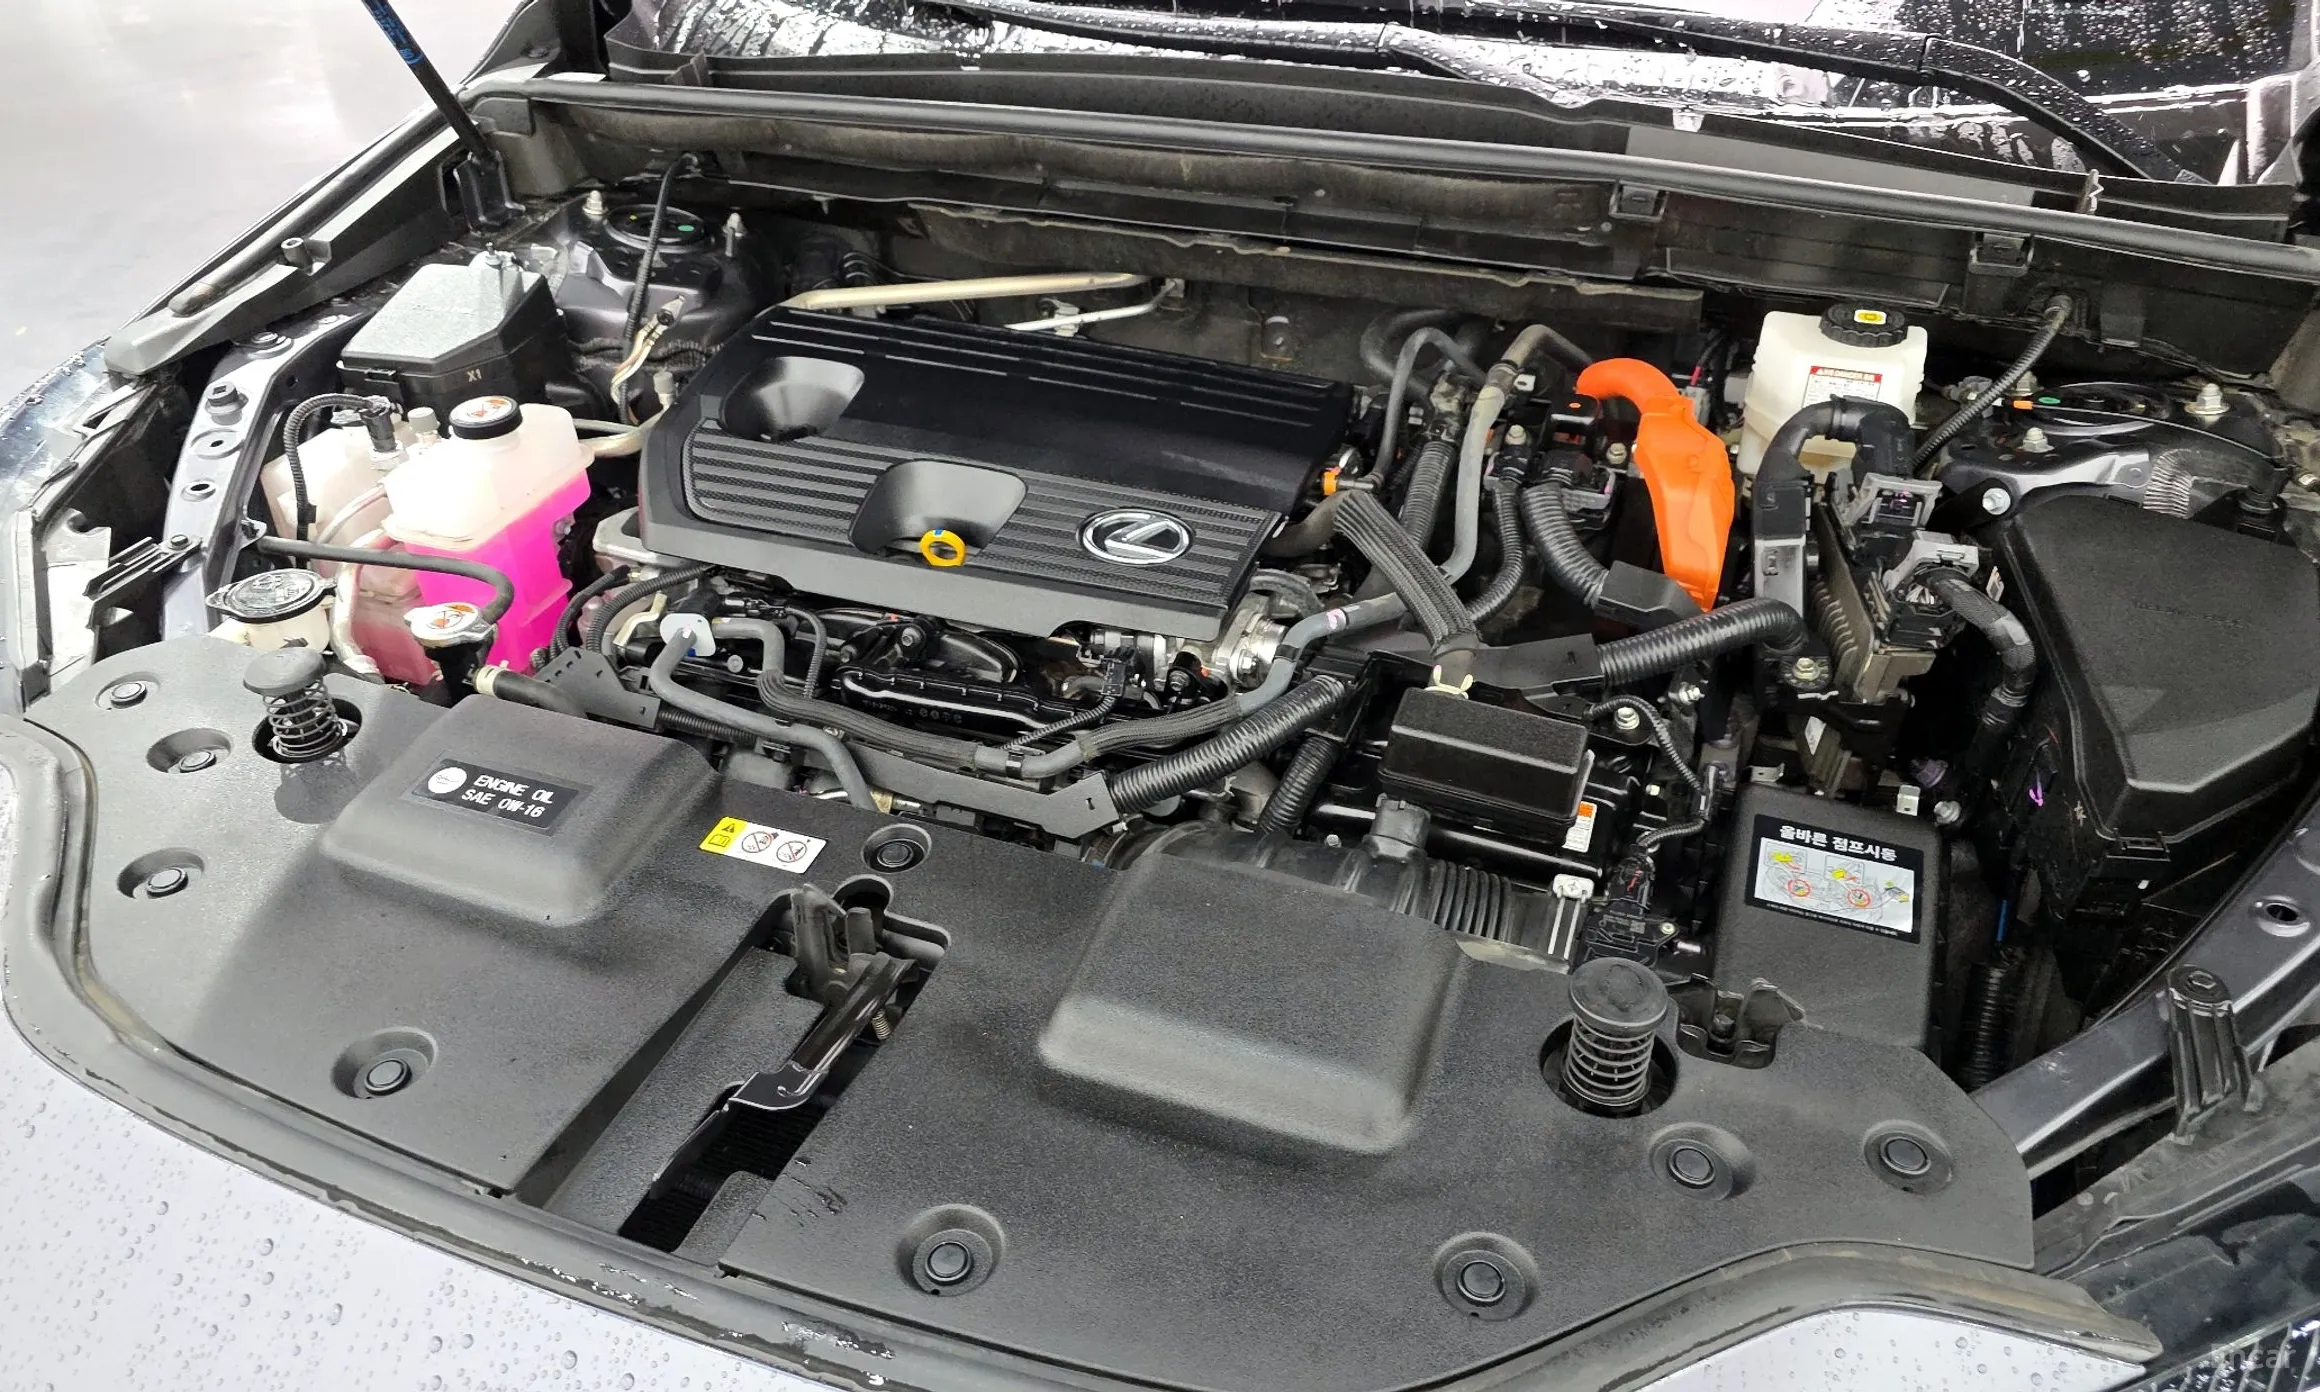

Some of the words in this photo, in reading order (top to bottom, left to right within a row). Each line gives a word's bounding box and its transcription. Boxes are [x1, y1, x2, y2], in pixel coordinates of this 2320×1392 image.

[461, 788, 496, 806] SAE
[497, 798, 546, 818] 0W-16
[473, 774, 530, 797] ENGINE
[531, 789, 555, 805] OIL
[1779, 824, 1828, 848] 올바른
[1832, 835, 1898, 862] 점프시동
